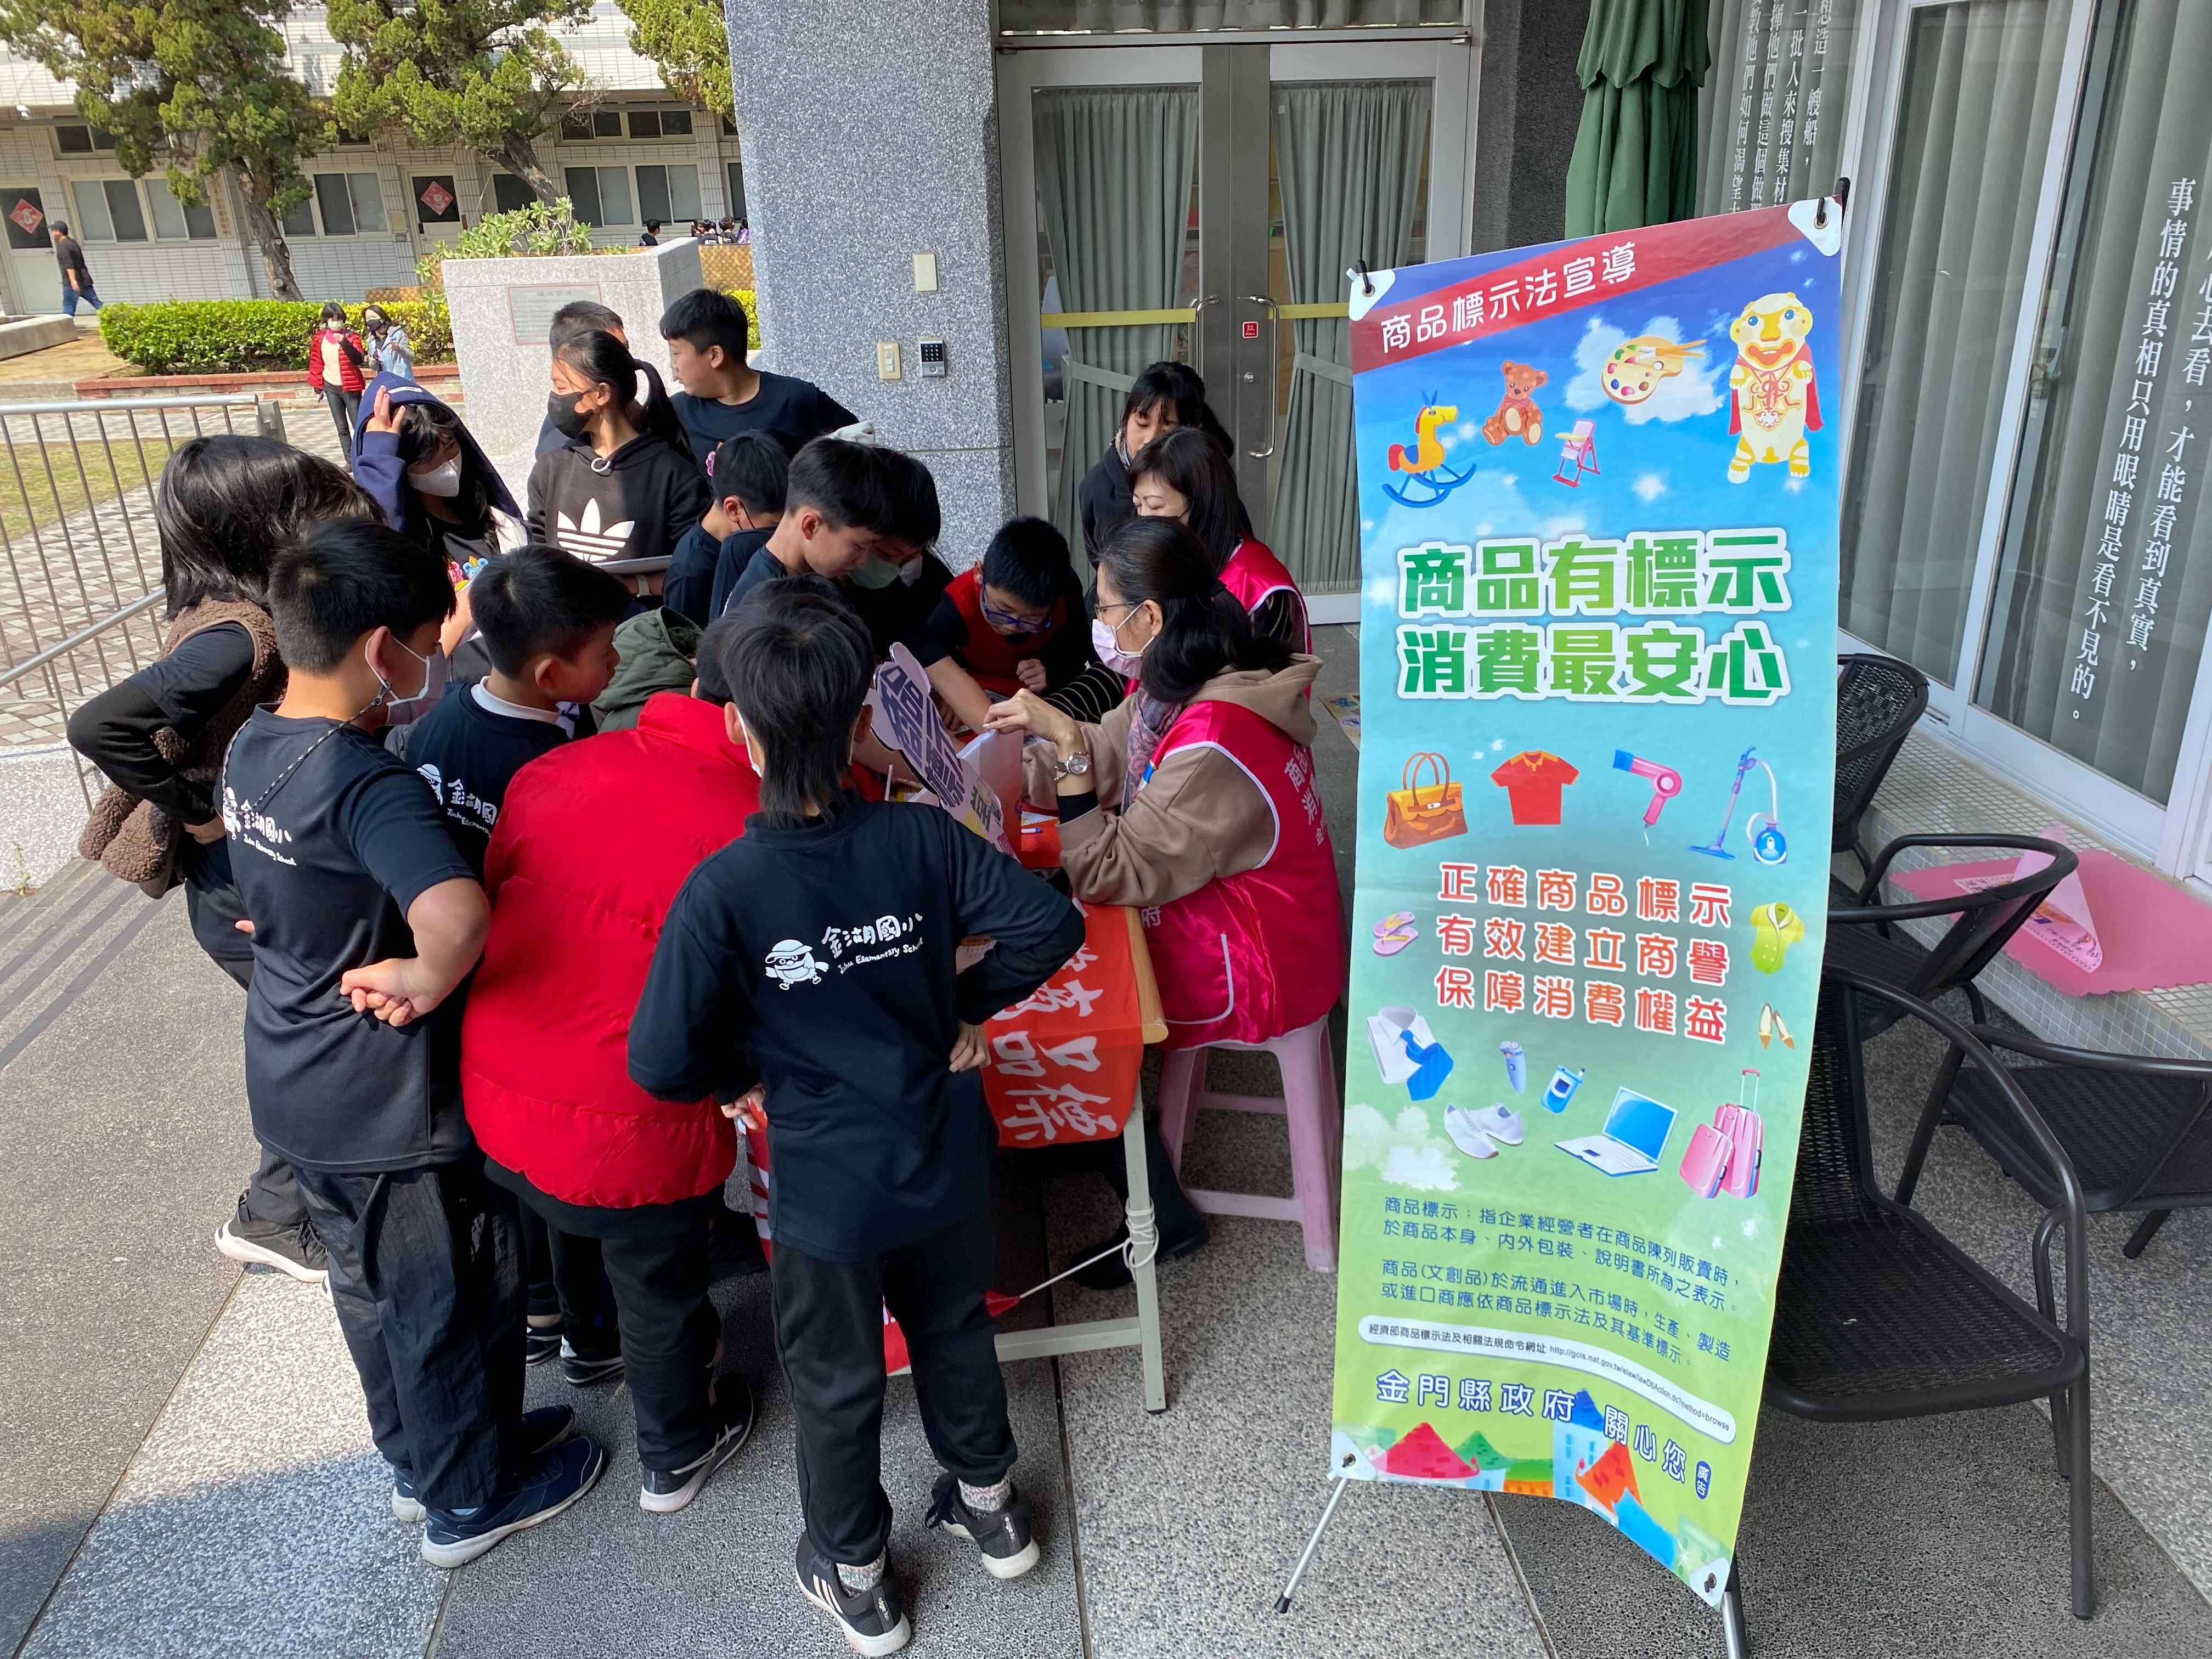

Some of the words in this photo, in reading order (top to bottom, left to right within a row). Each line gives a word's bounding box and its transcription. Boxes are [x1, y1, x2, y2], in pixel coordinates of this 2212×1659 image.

[1381, 241, 1636, 353] 商品標示法宣導
[2126, 241, 2212, 671] 去看，才能看到真實，
[1398, 528, 1791, 617] 商品有標示
[1398, 624, 1790, 704] 消費最安心
[821, 913, 923, 958] 金湖國小
[1438, 862, 1731, 929] 正確商品標示
[1436, 916, 1730, 986] 有效建立商譽
[1434, 967, 1727, 1045] 保障消費權益
[1384, 1197, 1739, 1286] 商品標示：指企業經營者在商品陳列販賣時，
[1381, 1282, 1691, 1365] 或進口商應依商品標示法及其基準標示。
[1376, 1369, 1576, 1423] 金門縣政府
[1603, 1404, 1686, 1484] 關心您
